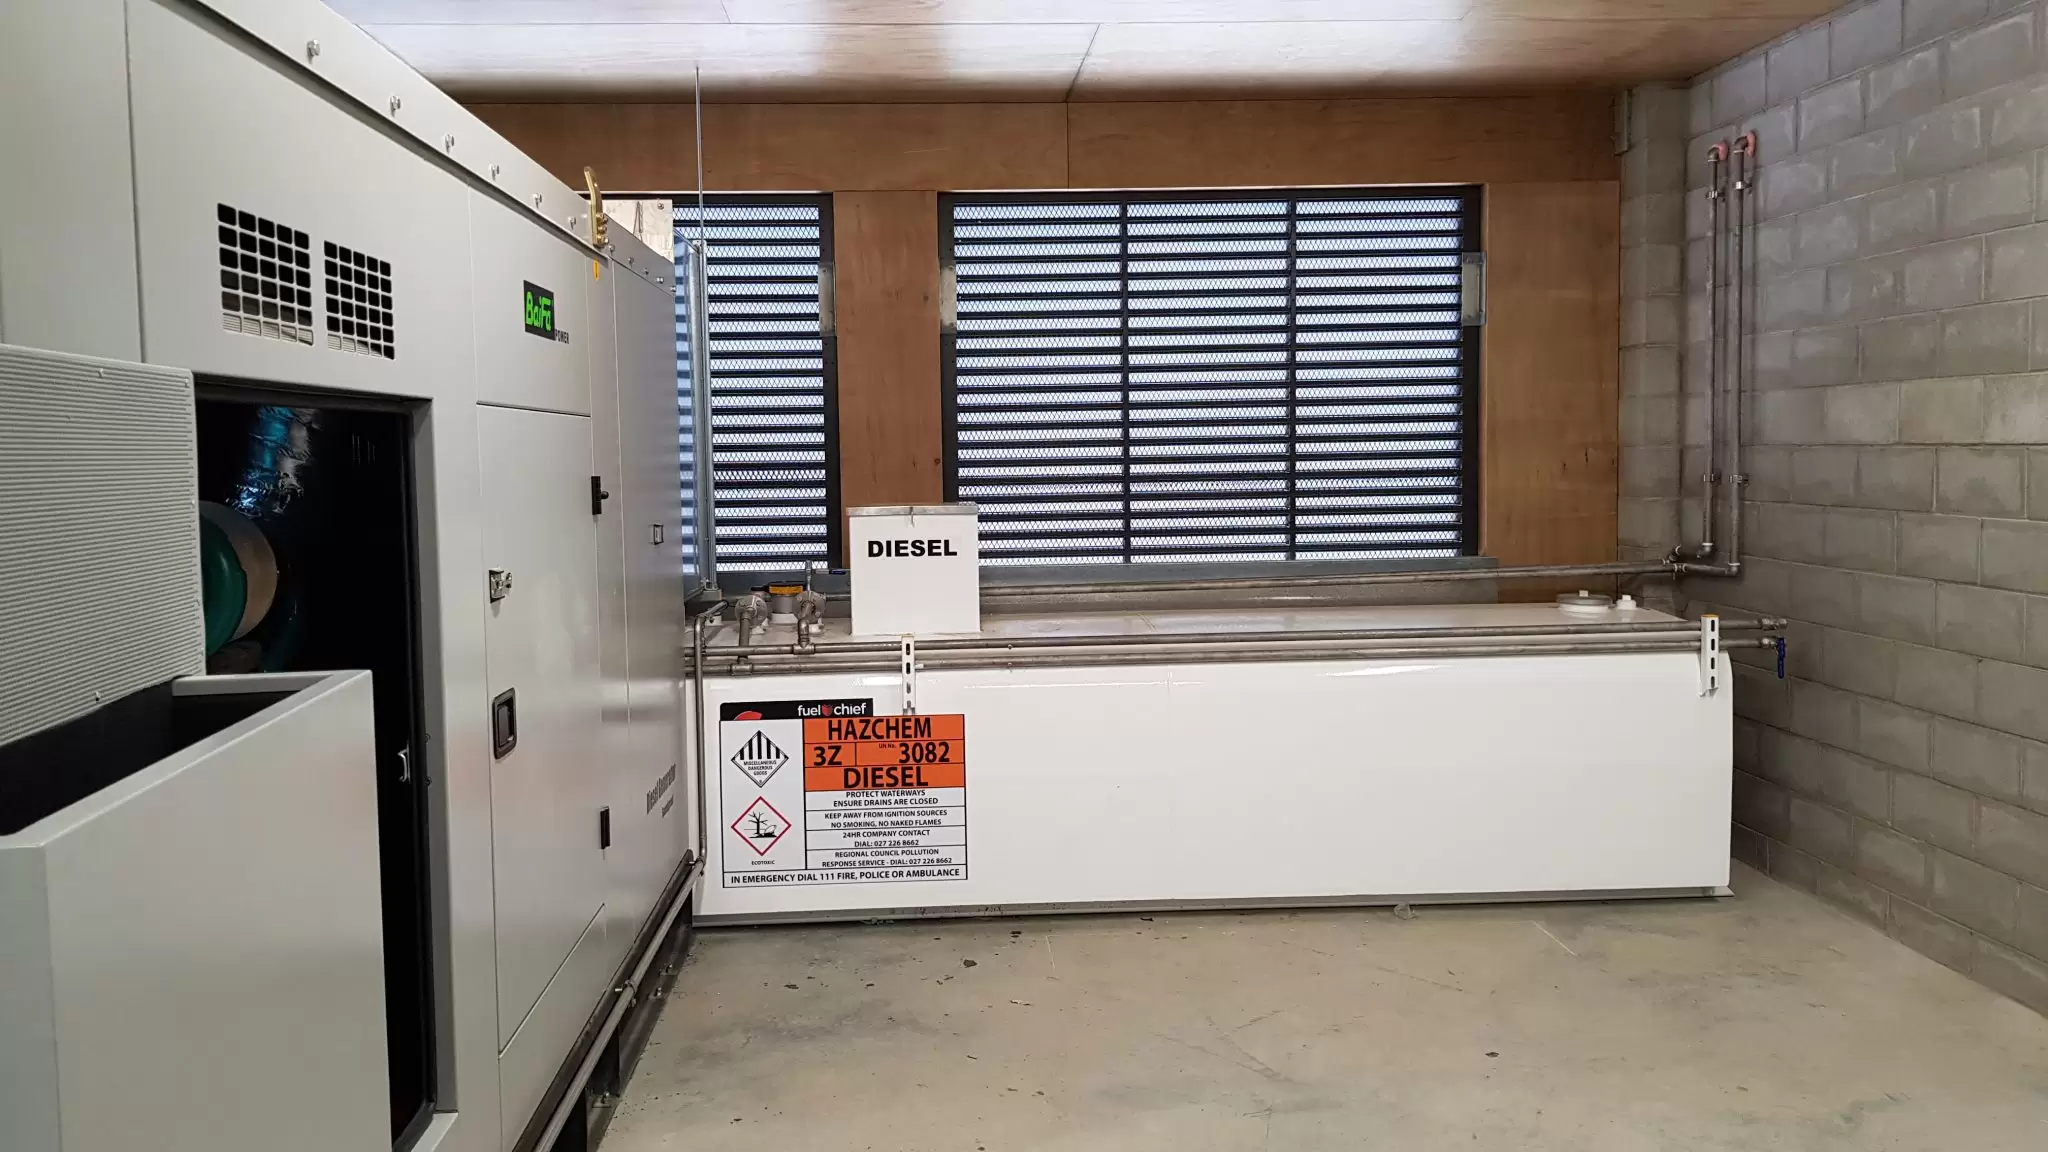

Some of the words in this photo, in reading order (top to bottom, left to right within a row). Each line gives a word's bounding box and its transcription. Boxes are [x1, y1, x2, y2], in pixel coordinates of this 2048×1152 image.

[868, 539, 958, 557] DIESEL
[797, 704, 821, 717] fuel
[833, 702, 867, 716] chief
[828, 717, 932, 741] HAZCHEM
[813, 745, 842, 766] 3Z
[899, 741, 950, 764] 3082
[843, 766, 929, 789] DIESEL
[846, 790, 879, 798] PROTECT
[885, 810, 915, 818] IGNITION
[862, 830, 897, 838] COMPANY
[835, 850, 869, 858] REGIONAL
[731, 876, 740, 884] IN
[742, 874, 796, 883] EMERGENCY
[797, 873, 818, 881] DIAL
[837, 872, 858, 880] FIRE,
[860, 871, 890, 879] POLICE
[891, 870, 904, 878] OR
[906, 869, 960, 878] AMBULANCE
